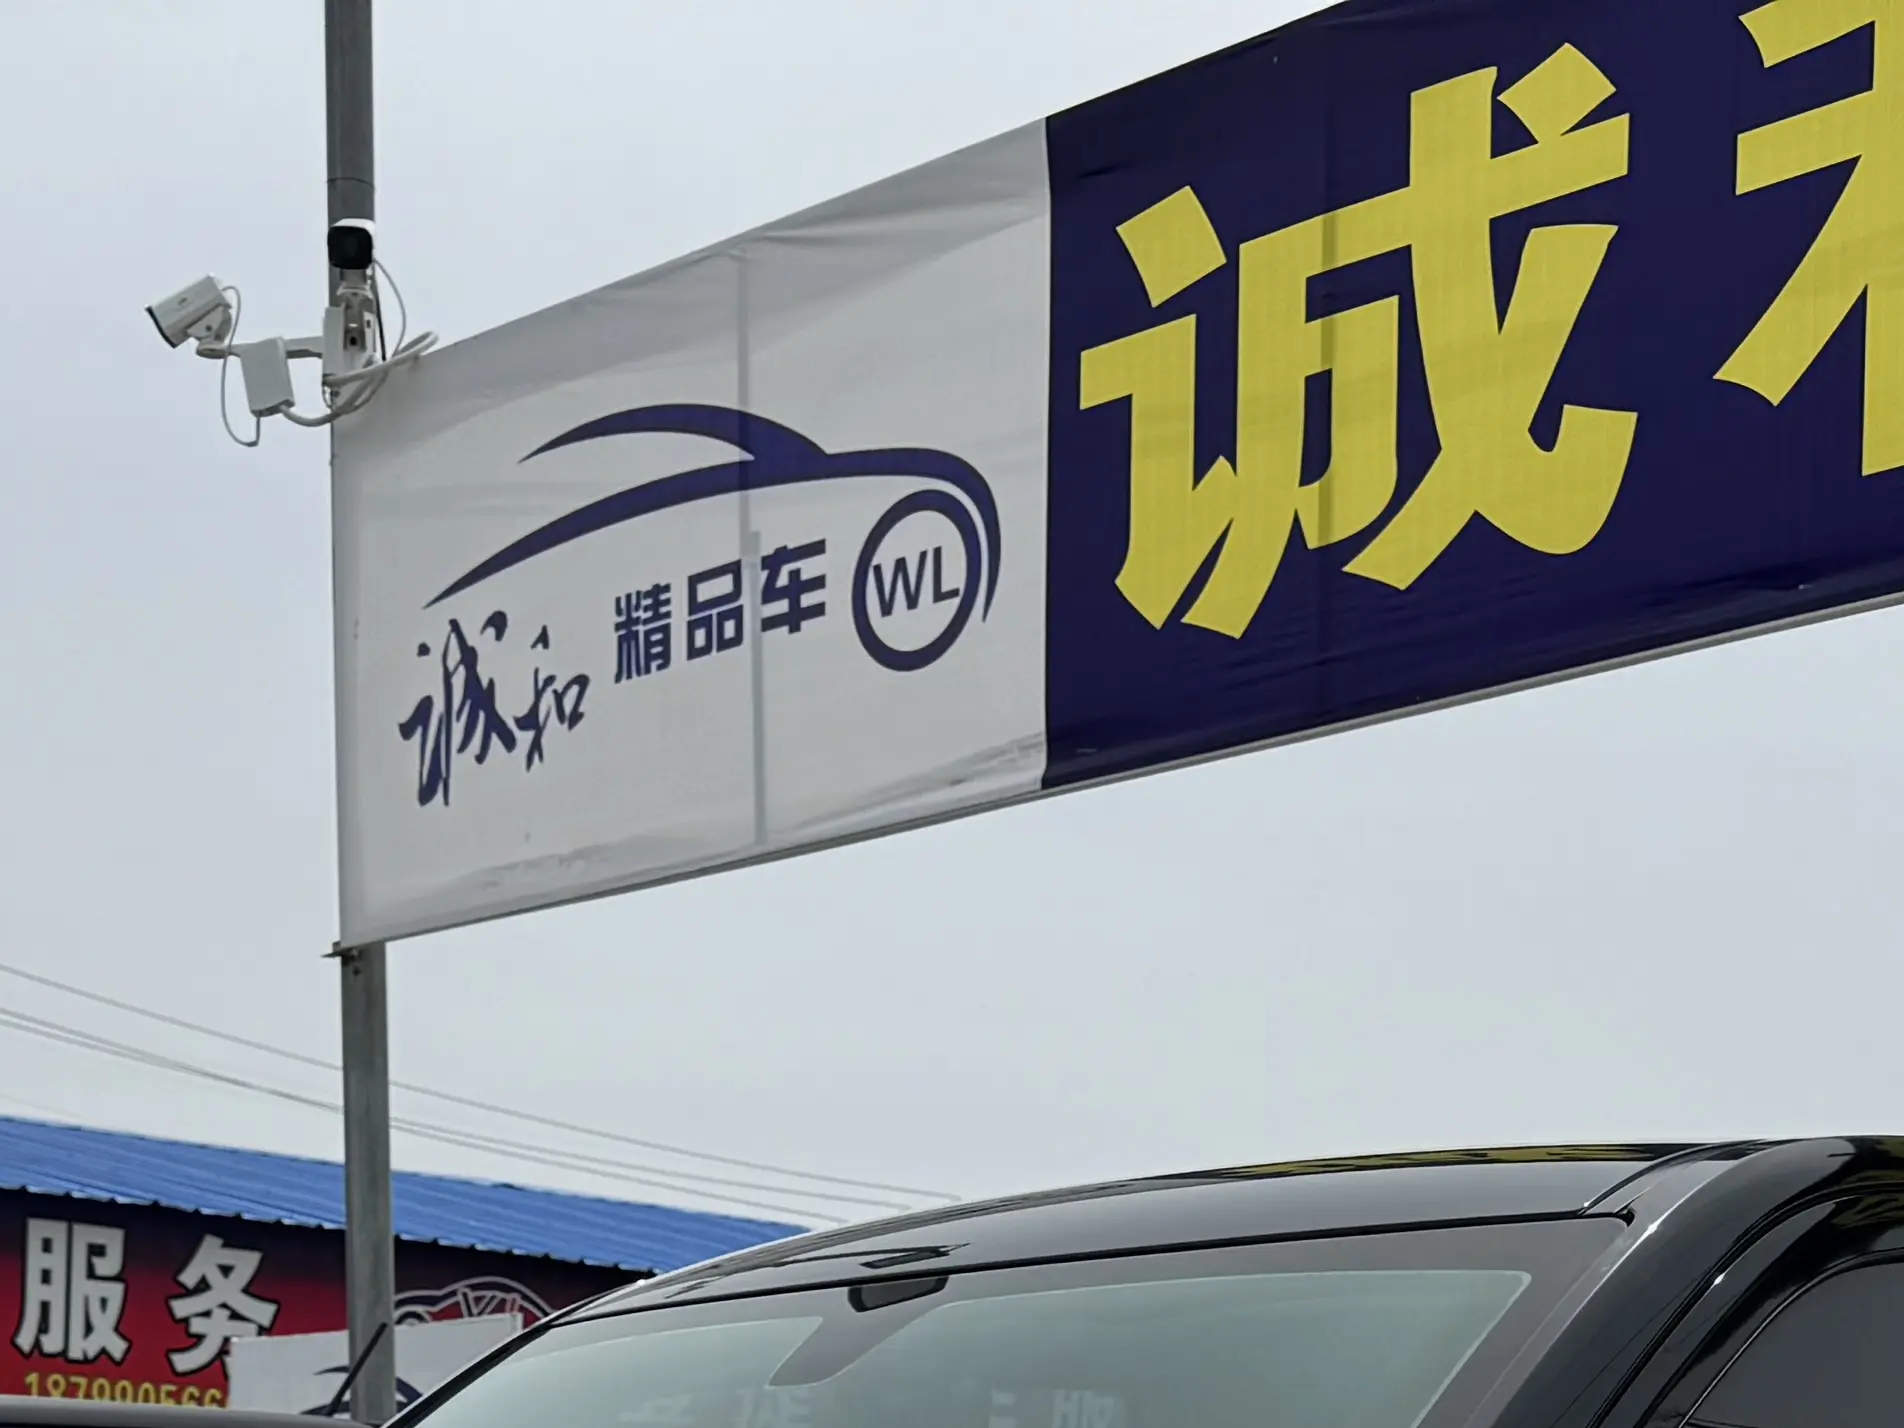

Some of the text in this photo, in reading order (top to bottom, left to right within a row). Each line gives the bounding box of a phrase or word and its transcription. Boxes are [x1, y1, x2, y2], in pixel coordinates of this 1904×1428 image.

[613, 537, 827, 684] 精品车
[871, 545, 961, 619] WL
